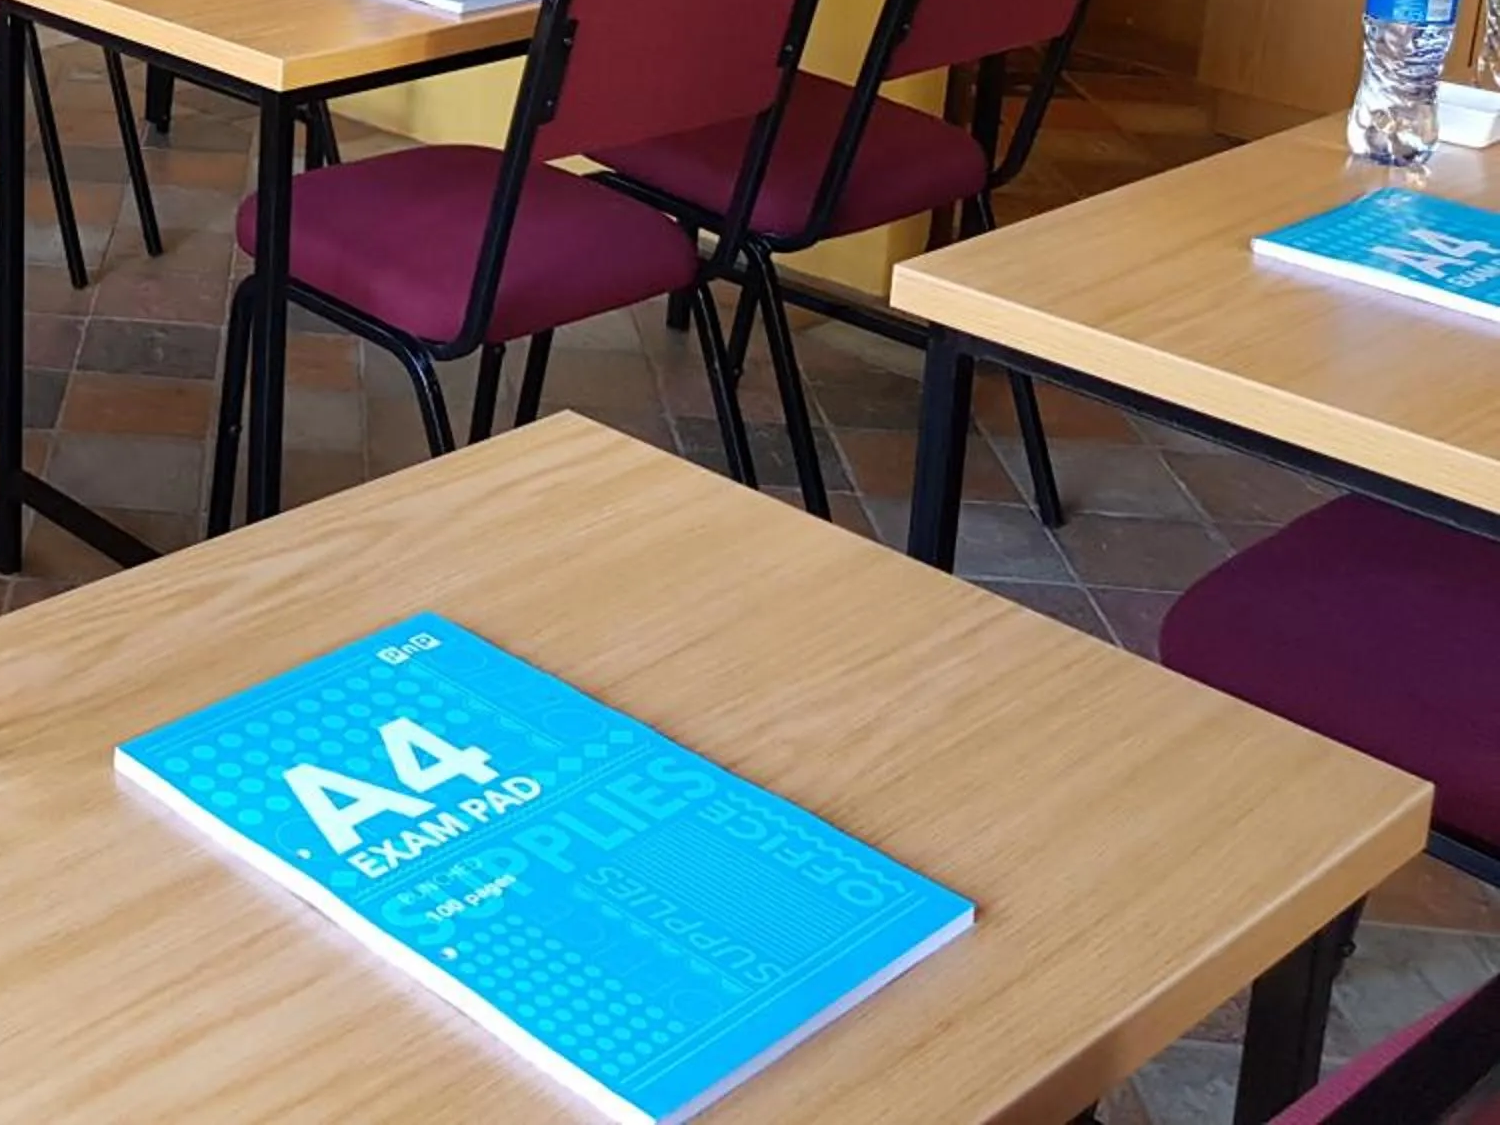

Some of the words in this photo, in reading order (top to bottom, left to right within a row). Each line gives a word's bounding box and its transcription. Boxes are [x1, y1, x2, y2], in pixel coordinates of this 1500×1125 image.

[1371, 229, 1500, 279] A4
[282, 716, 500, 855] A4
[347, 811, 470, 879] EXAM
[458, 776, 541, 823] PAD
[697, 799, 885, 908] OFFICE
[425, 897, 466, 923] 100
[586, 866, 788, 984] SUPPLIES
